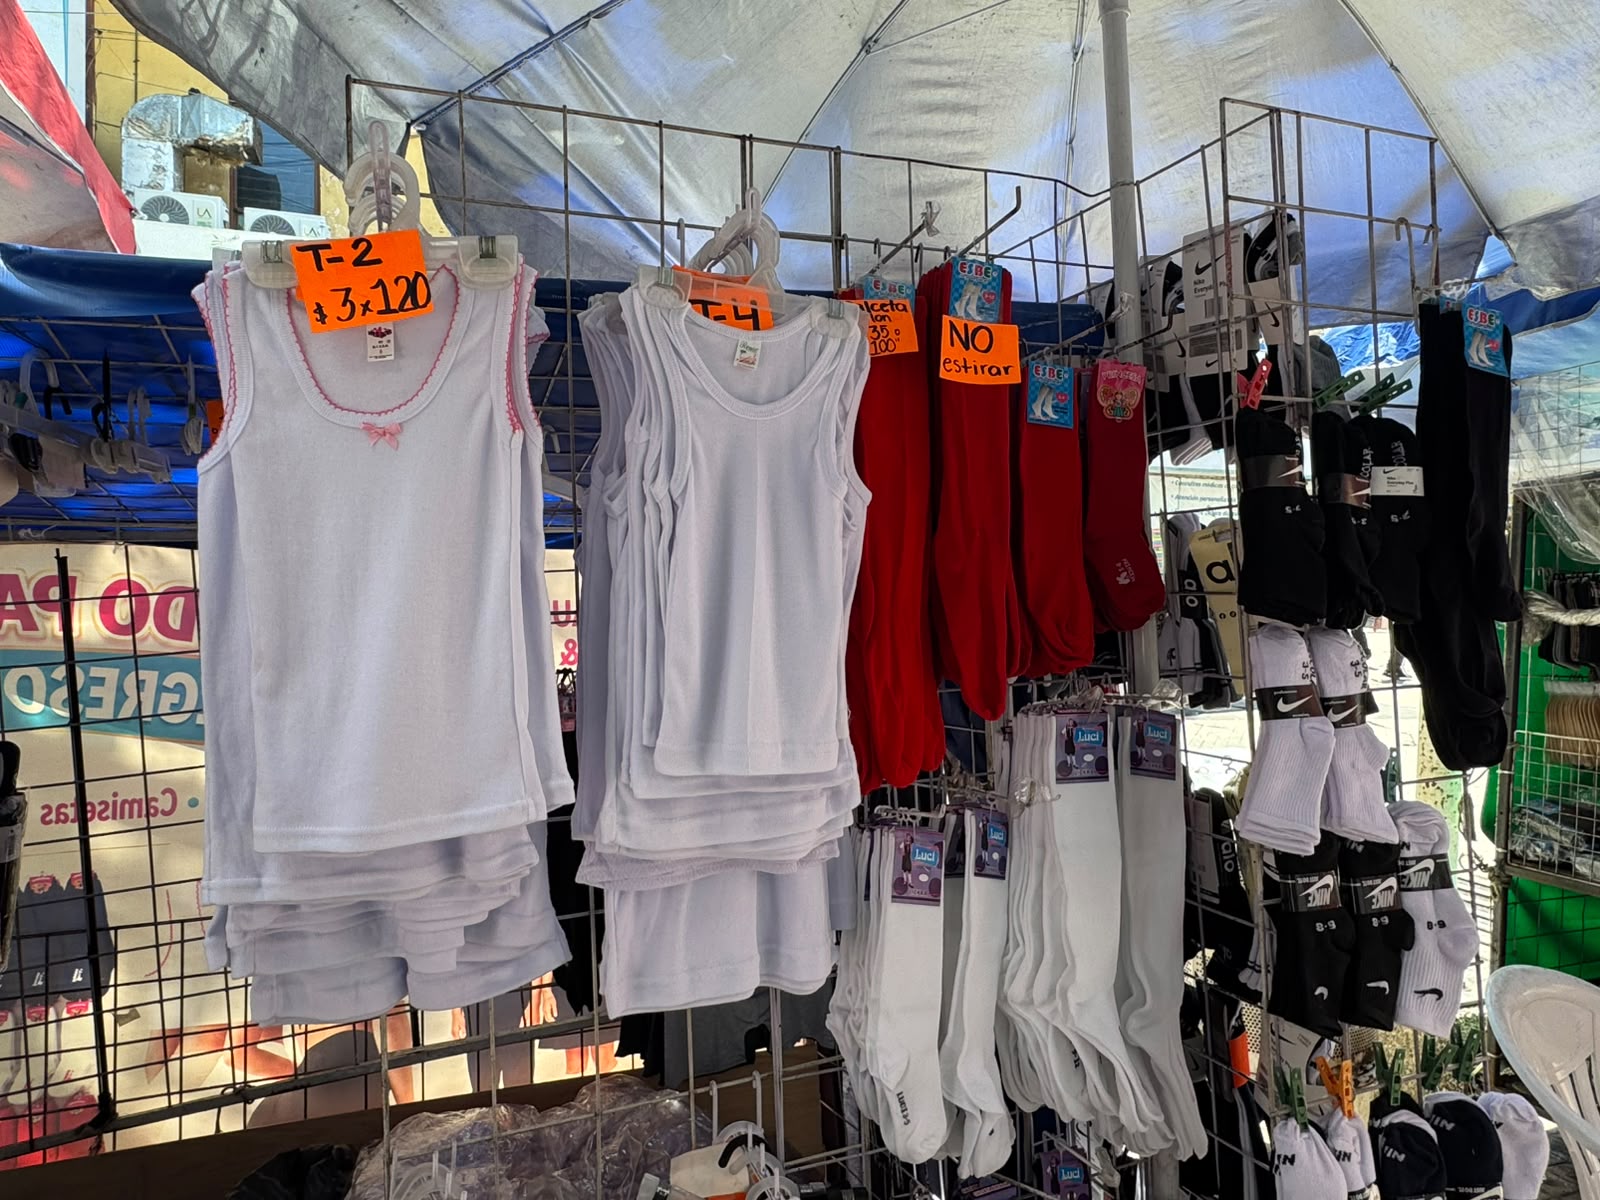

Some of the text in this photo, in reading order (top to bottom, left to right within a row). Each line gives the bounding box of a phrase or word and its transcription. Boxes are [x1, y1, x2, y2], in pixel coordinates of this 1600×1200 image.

[958, 260, 992, 279] ESBE
[873, 279, 906, 295] ESBE
[1467, 307, 1496, 327] ESBE
[949, 320, 994, 353] NO
[942, 357, 1015, 377] estirar
[1033, 364, 1064, 380] ESBE
[1350, 660, 1362, 678] 3-5
[1078, 730, 1100, 742] Luci
[1148, 726, 1168, 739] Luci
[989, 828, 1004, 840] Luci
[914, 848, 936, 862] Luci
[1400, 870, 1431, 888] NIKE
[1307, 888, 1331, 908] NIKE
[1371, 890, 1396, 910] NIKE
[1060, 1168, 1081, 1181] Luci
